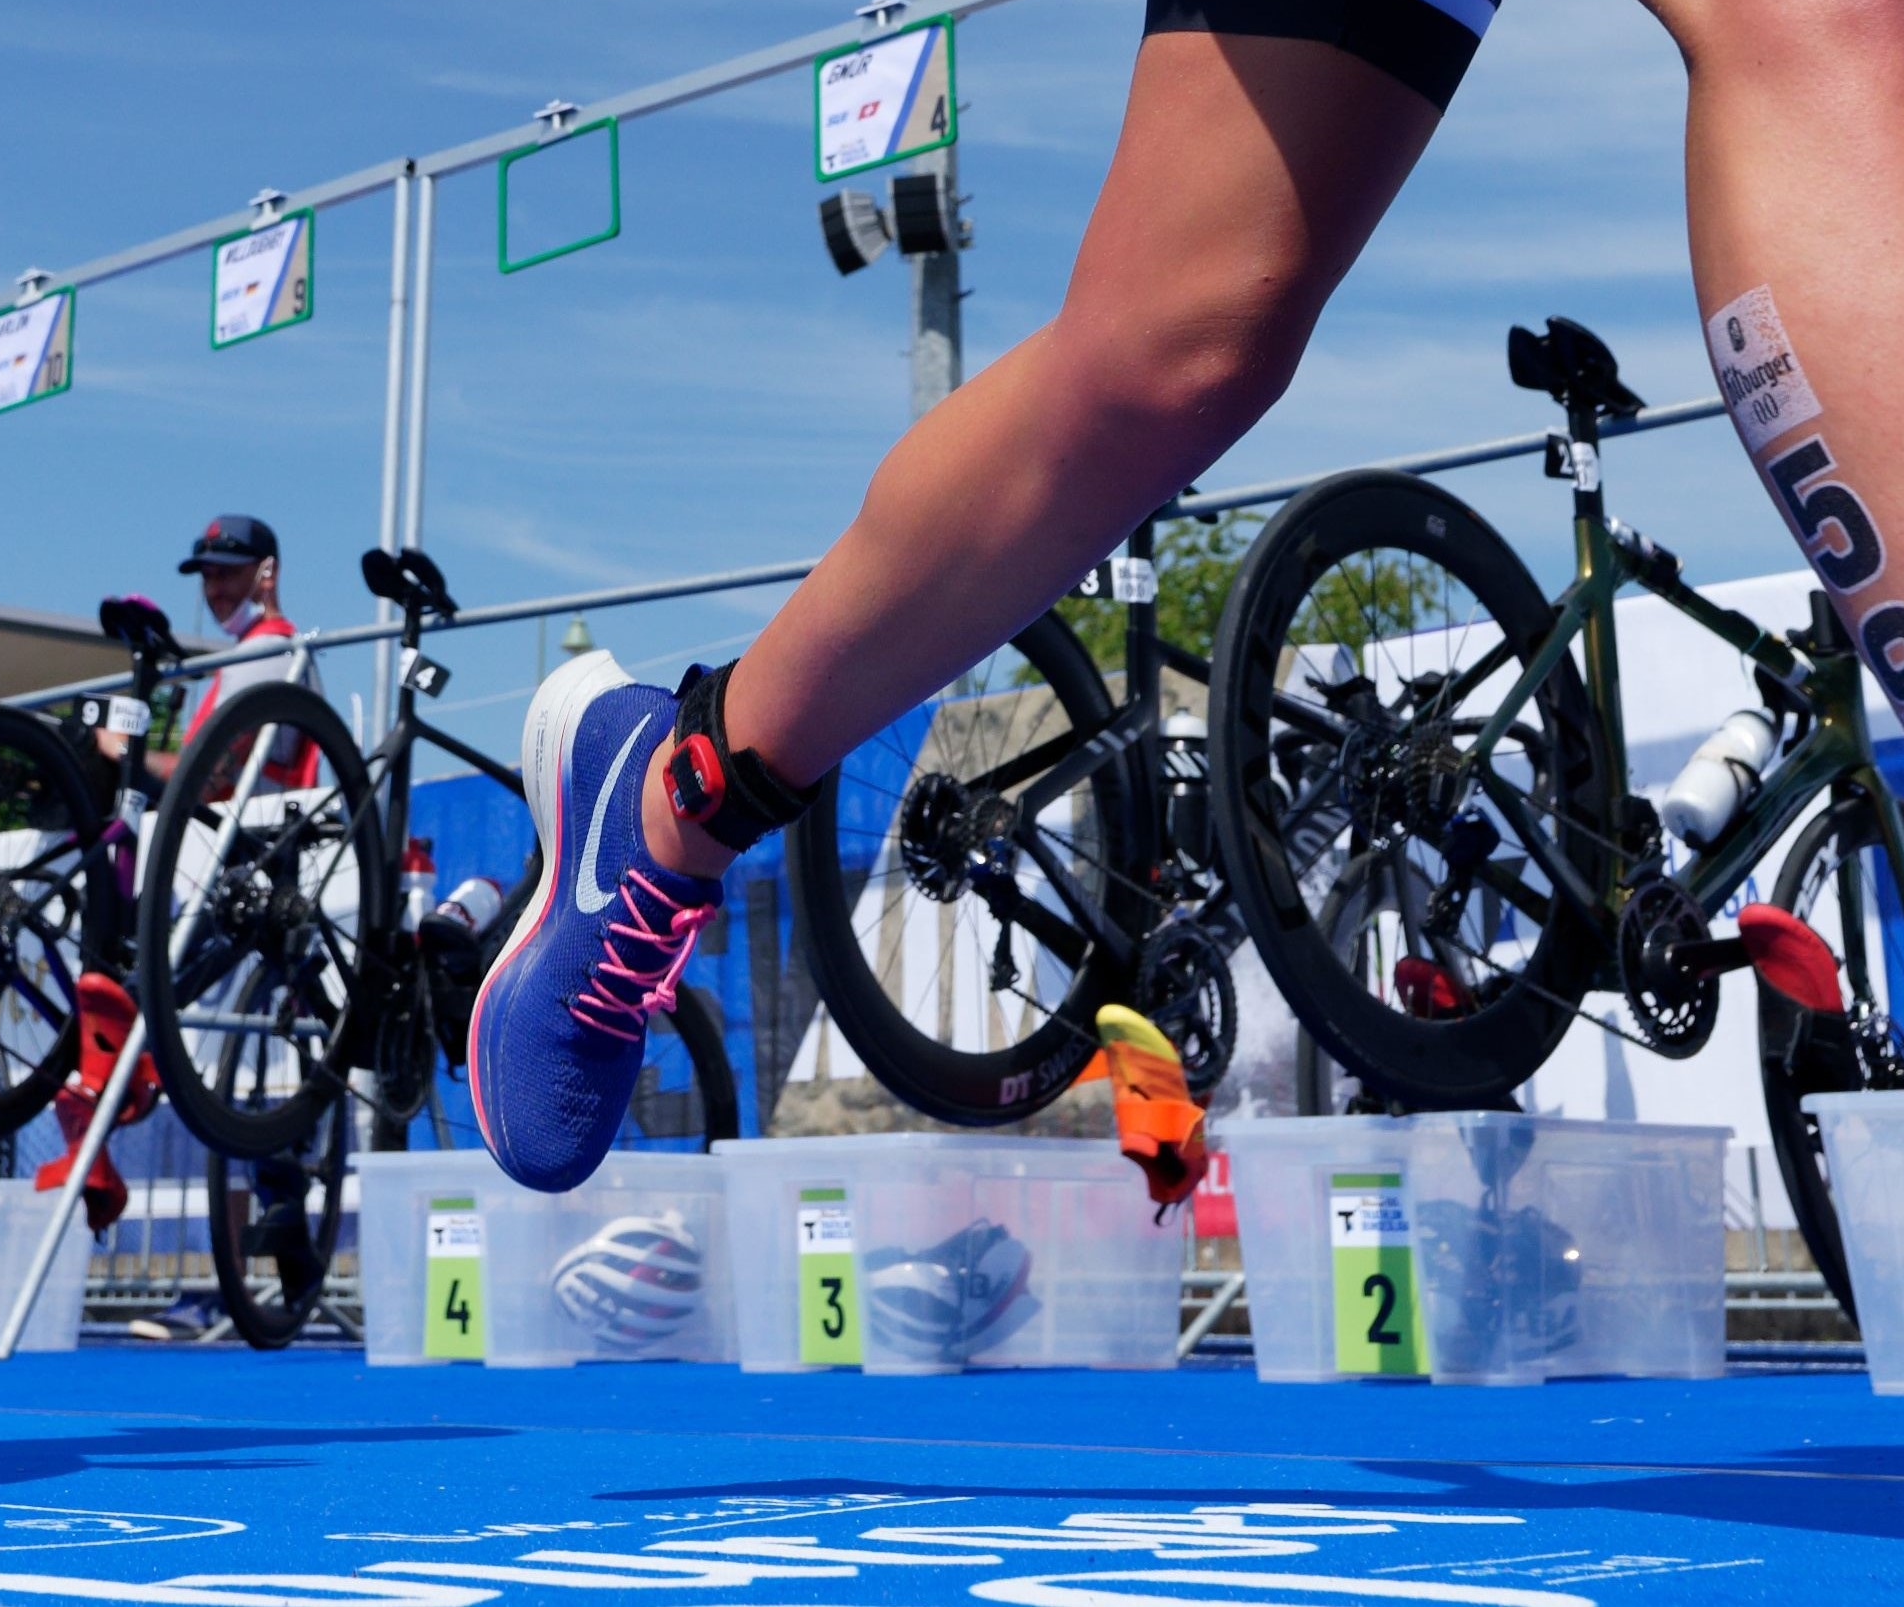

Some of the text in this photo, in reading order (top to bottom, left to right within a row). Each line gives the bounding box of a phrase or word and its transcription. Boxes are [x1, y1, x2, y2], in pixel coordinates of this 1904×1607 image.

[929, 94, 947, 138] 4
[292, 277, 307, 315] 9
[1721, 351, 1793, 407] Bitburger
[1557, 443, 1574, 475] 2
[445, 1278, 471, 1336] 4
[820, 1277, 845, 1339] 3
[1363, 1273, 1401, 1344] 2
